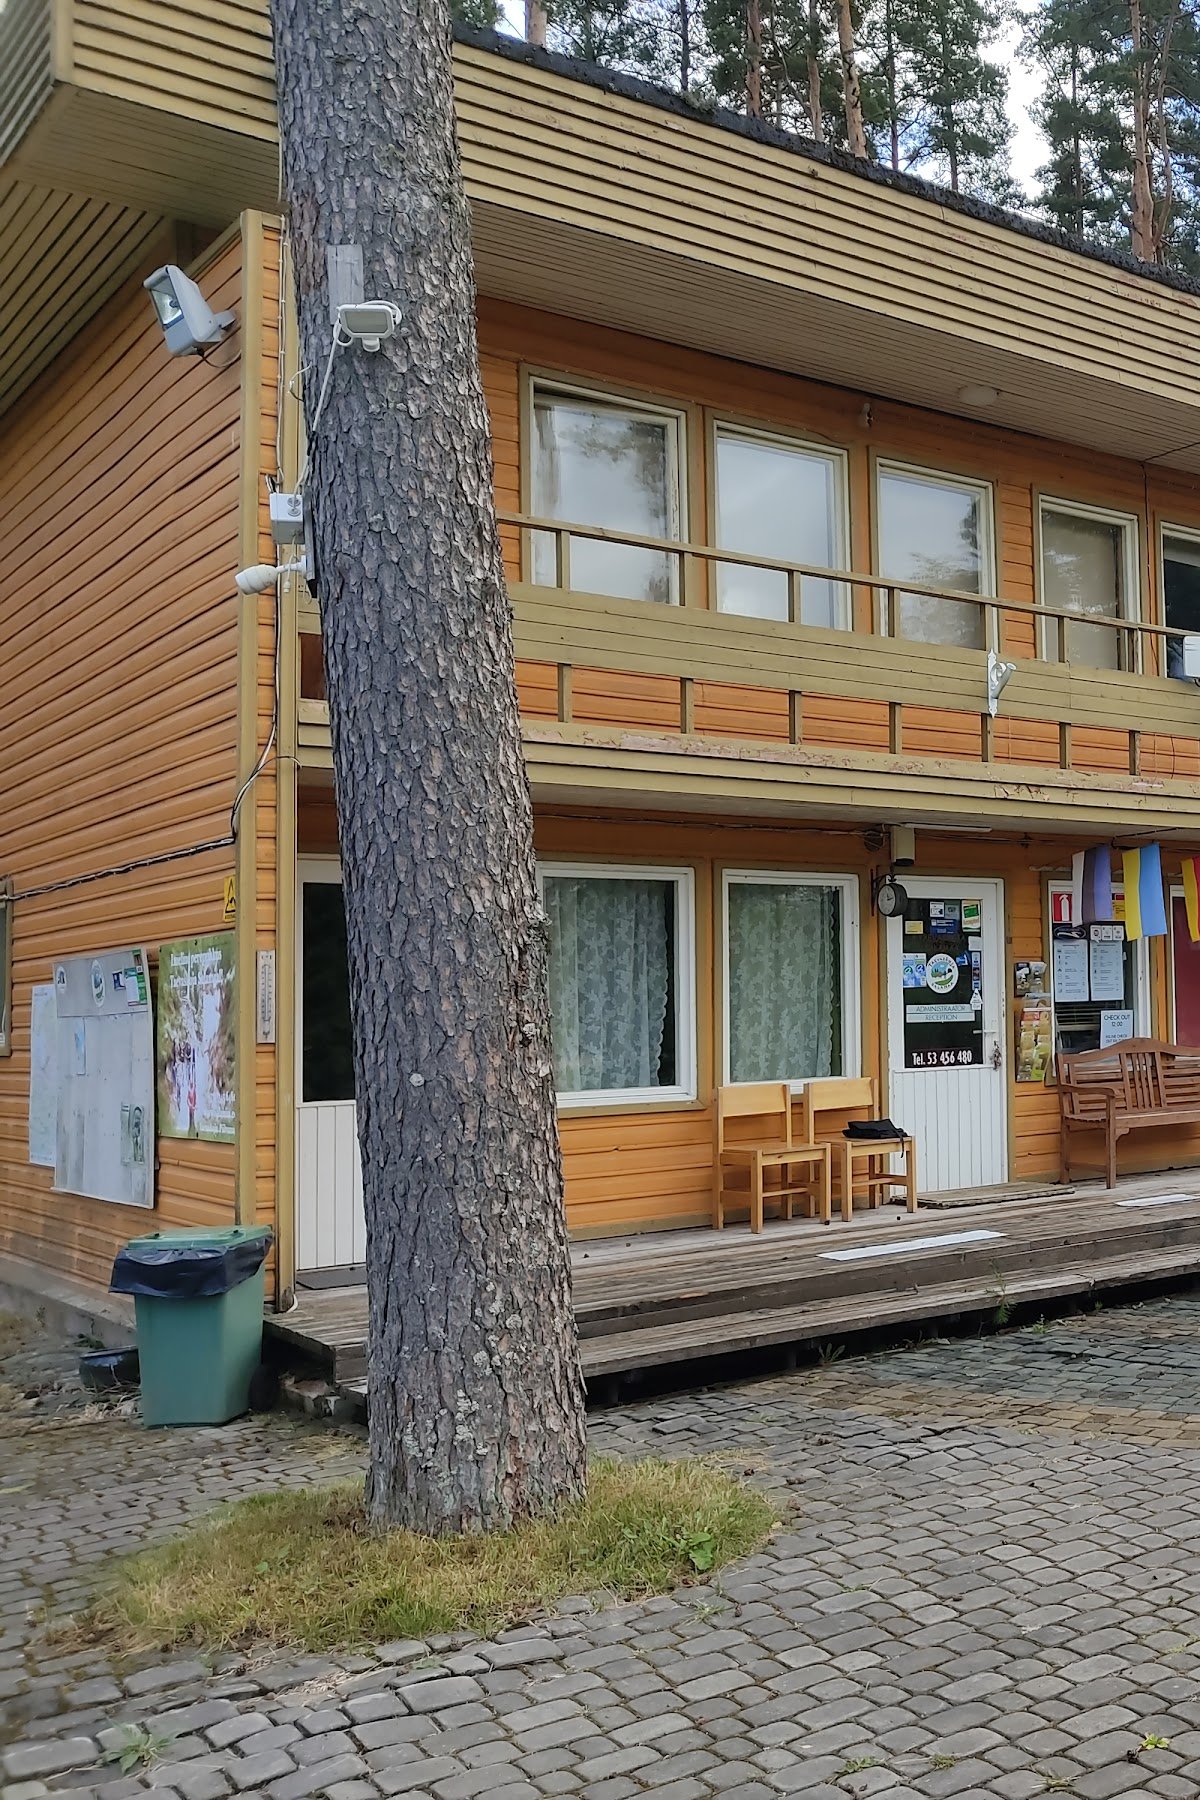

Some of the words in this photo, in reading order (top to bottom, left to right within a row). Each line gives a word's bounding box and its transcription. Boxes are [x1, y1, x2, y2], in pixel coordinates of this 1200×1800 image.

[911, 1052, 926, 1066] Tel.
[926, 1051, 937, 1065] 53
[939, 1050, 955, 1065] 456
[956, 1049, 973, 1064] 480
